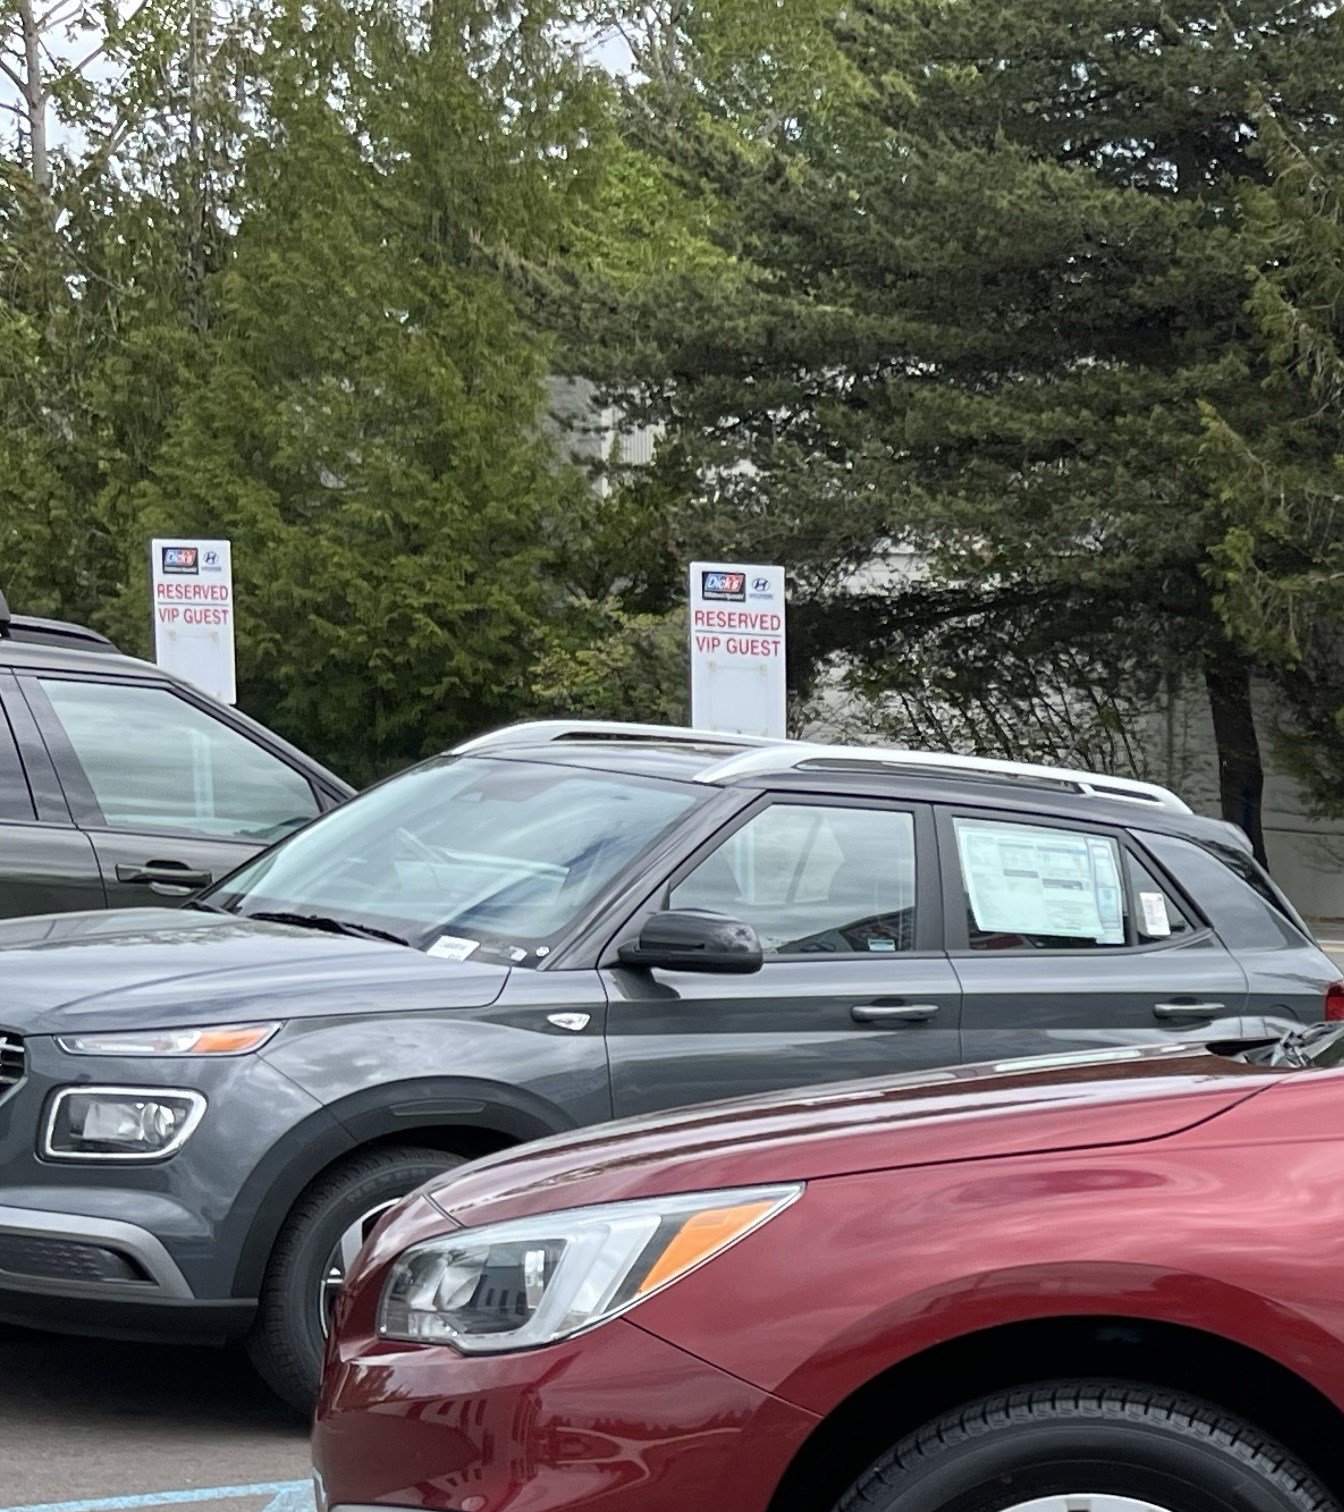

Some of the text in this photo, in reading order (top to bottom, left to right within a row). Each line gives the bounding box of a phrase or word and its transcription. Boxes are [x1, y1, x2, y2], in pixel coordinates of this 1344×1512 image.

[157, 583, 229, 601] RESERVED
[158, 607, 229, 625] VIP GUEST
[694, 609, 781, 631] RESERVED
[695, 635, 781, 657] VIP GUEST
